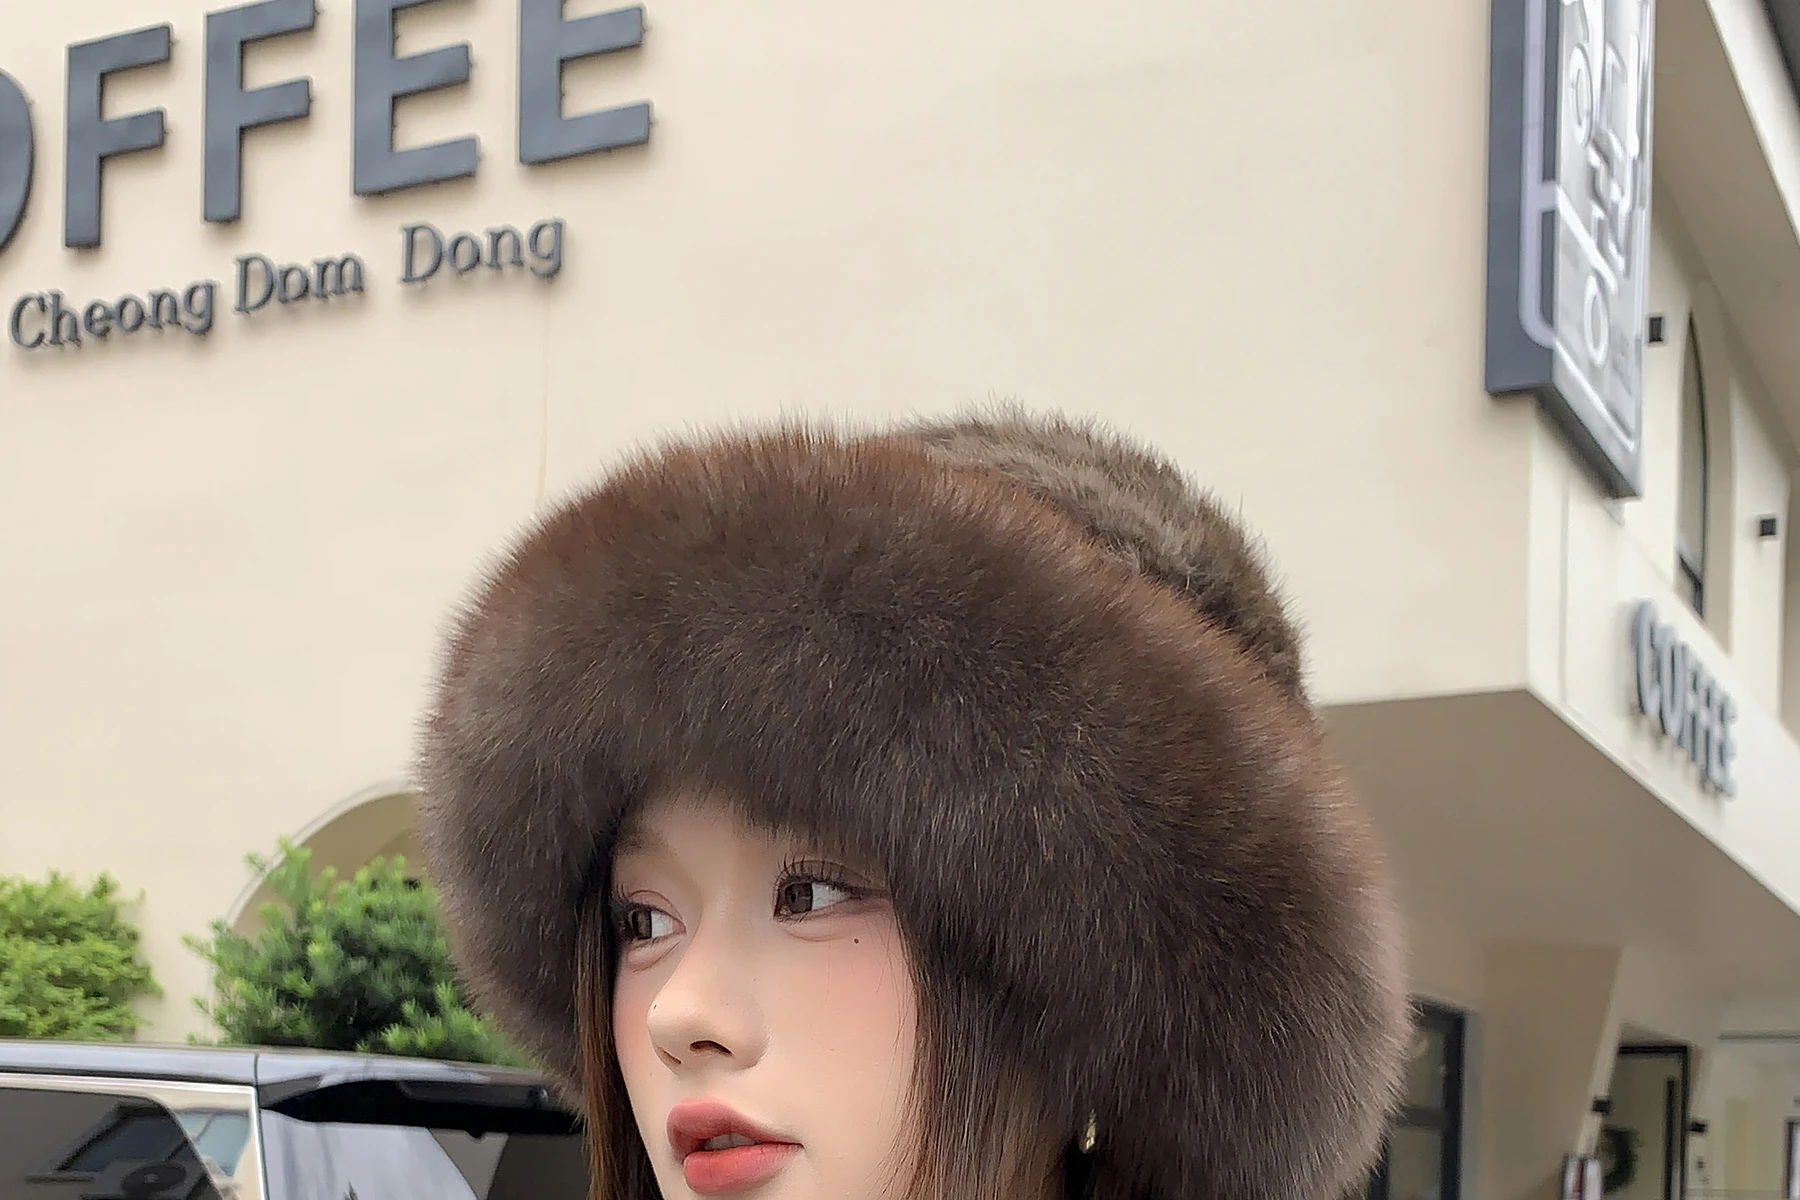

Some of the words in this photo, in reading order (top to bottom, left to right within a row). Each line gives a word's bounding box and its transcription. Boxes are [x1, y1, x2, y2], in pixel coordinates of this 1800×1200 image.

[9, 280, 216, 348] Cheong
[400, 218, 565, 283] Dong
[1630, 598, 1737, 798] COFFEE
